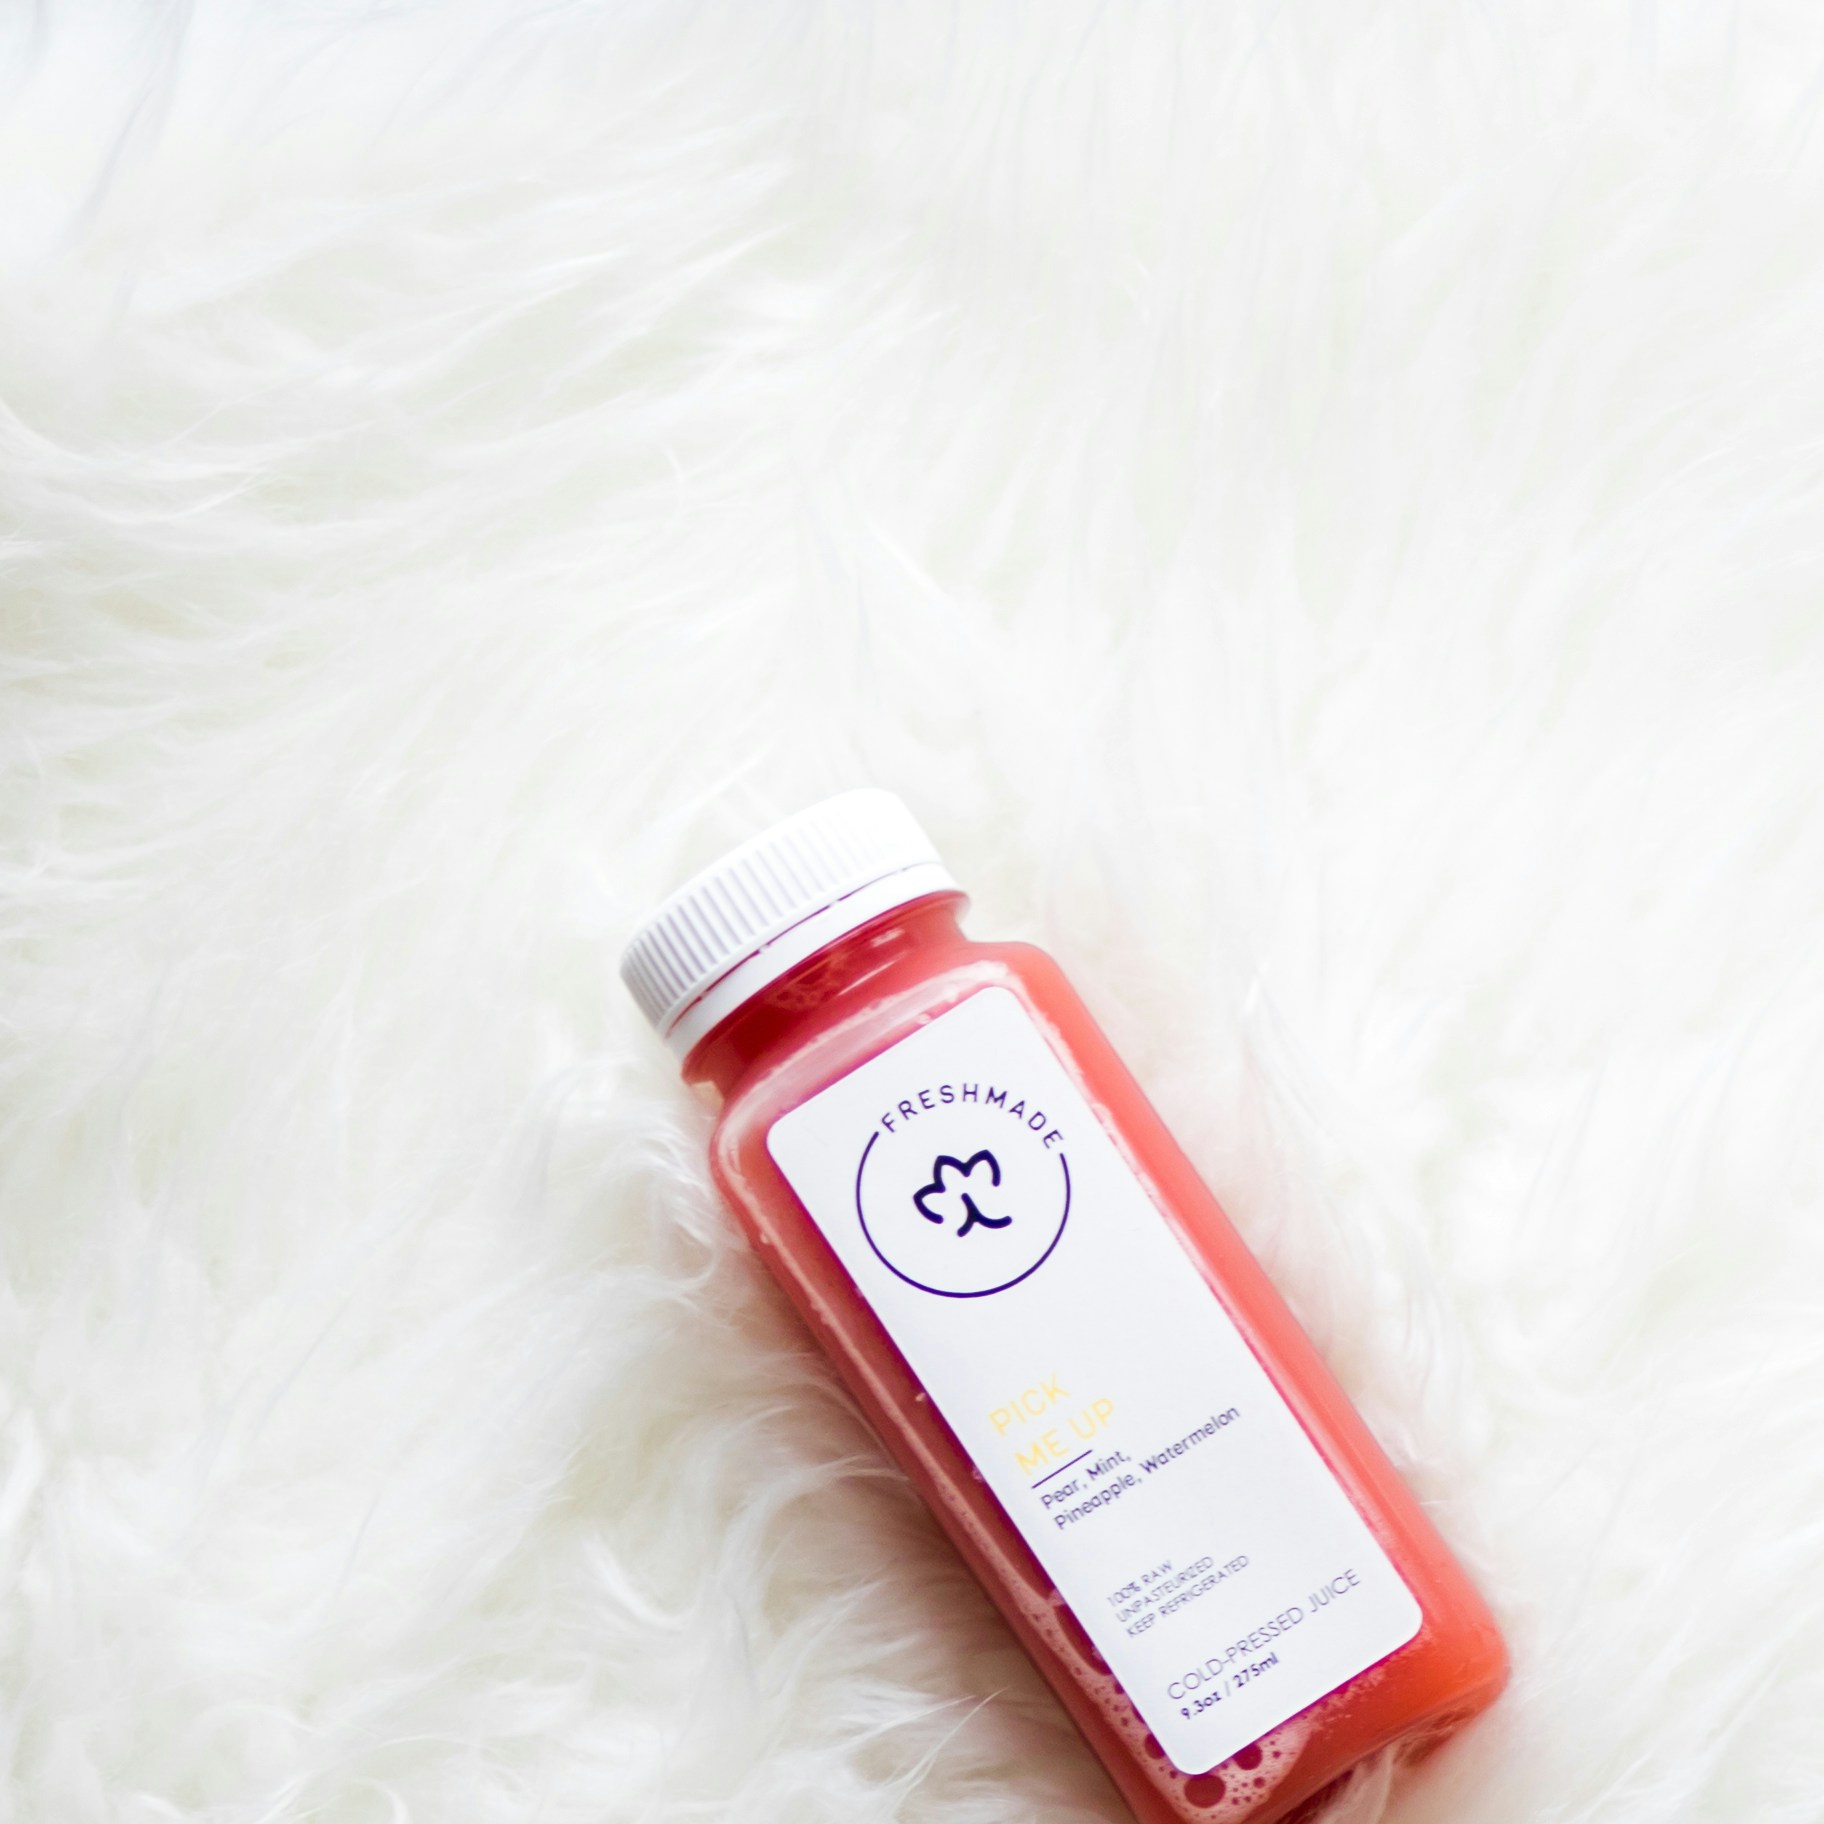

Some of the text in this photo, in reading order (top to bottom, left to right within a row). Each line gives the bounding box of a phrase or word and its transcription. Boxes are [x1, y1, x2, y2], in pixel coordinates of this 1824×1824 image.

[880, 1082, 1064, 1150] FRESHMADE
[987, 1372, 1070, 1436] PICK
[1014, 1397, 1114, 1476] ME UP
[1040, 1451, 1131, 1510] Pear, Mint,
[1053, 1408, 1240, 1530] Pineapple, Watermelon
[1107, 1561, 1172, 1606] 100% RAW
[1116, 1557, 1213, 1622] UNPASTEURIZED
[1126, 1555, 1249, 1637] KEEP REFRIGERATED
[1167, 1569, 1360, 1700] COLD-PRESSED JUICE
[1181, 1691, 1222, 1719] 9.3oz
[1233, 1652, 1279, 1688] 275ml
